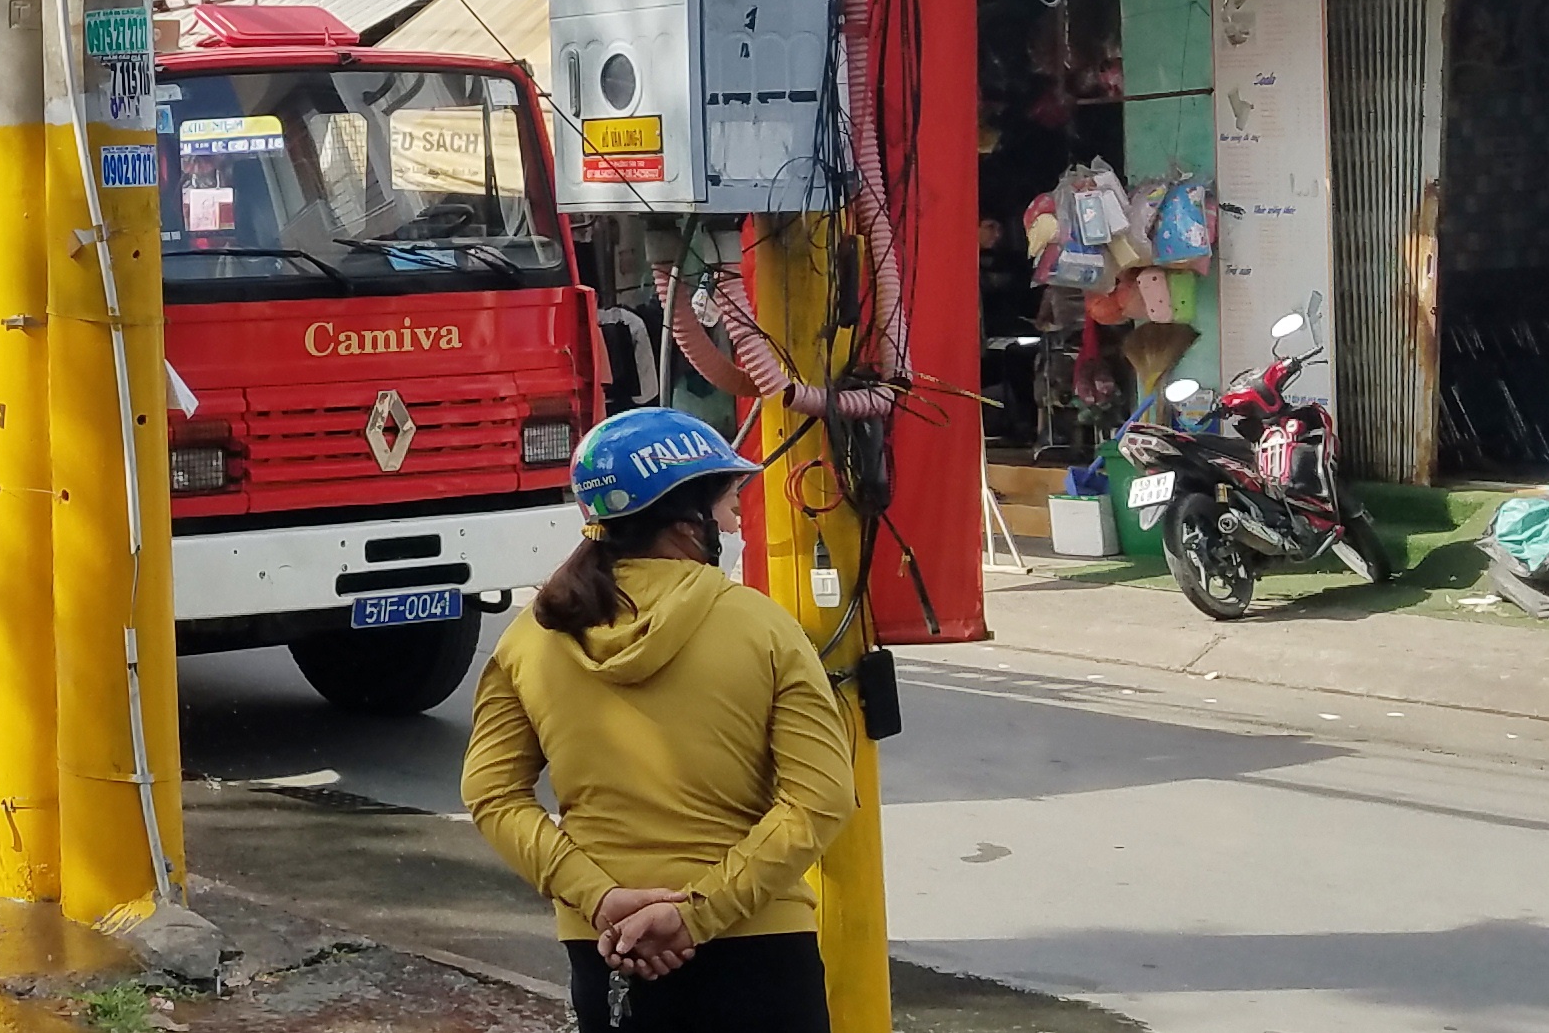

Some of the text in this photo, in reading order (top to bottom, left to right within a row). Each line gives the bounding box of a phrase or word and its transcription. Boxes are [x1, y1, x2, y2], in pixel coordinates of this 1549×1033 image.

[422, 127, 480, 154] SÁCH
[304, 317, 463, 357] Camiva
[629, 430, 713, 479] ITALIA
[365, 591, 450, 625] 51F-0041
